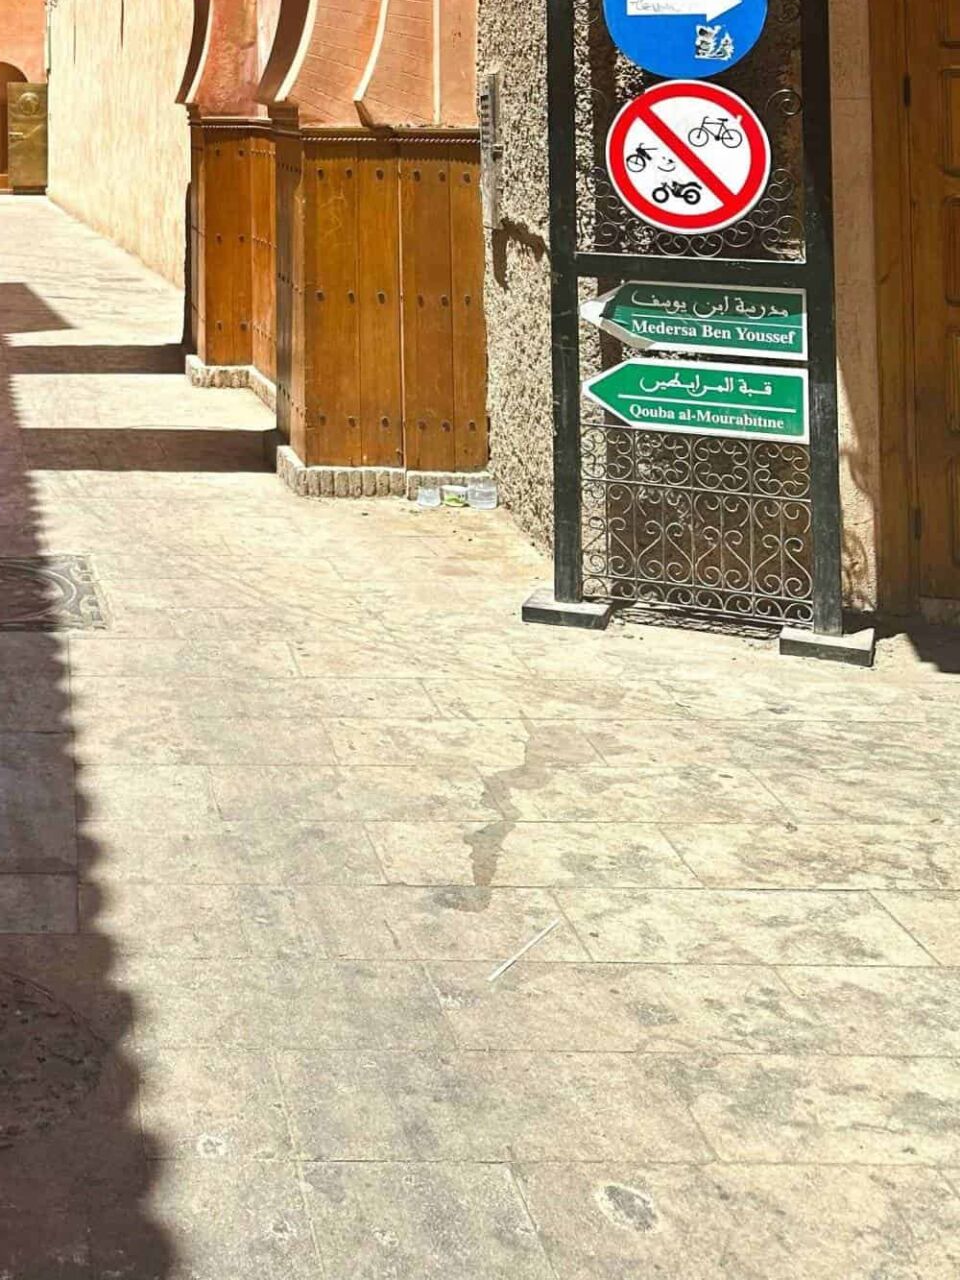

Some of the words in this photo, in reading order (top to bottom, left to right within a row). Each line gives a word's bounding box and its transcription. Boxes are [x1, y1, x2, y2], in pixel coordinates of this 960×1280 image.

[631, 289, 687, 314] يوسف
[693, 295, 729, 318] ابن
[734, 297, 789, 320] مدرسة
[631, 319, 697, 338] Medersa
[702, 324, 732, 340] Ben
[736, 327, 797, 345] Youssef
[738, 378, 773, 397] قبة
[629, 403, 675, 420] Qouba
[678, 408, 785, 429] al-Mourabitine
